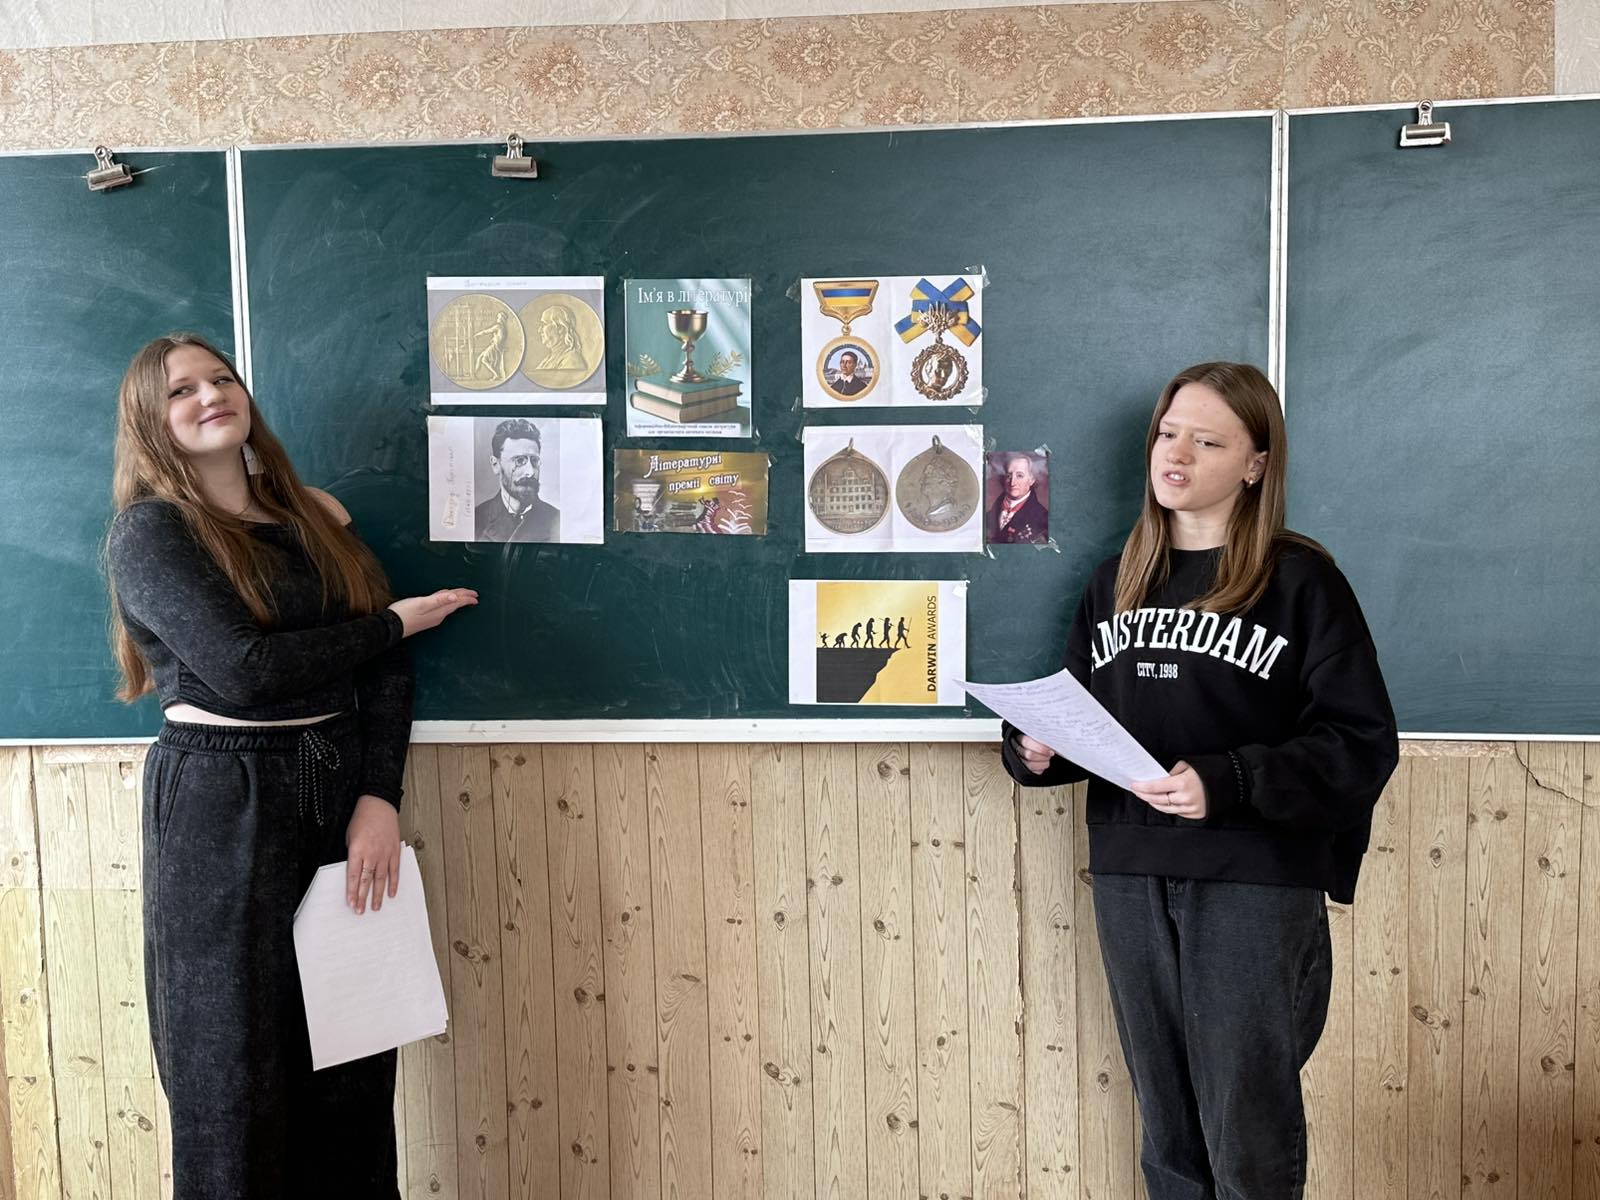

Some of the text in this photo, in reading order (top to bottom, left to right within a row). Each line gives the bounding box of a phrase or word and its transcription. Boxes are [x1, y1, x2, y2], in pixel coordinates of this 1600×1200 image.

[638, 287, 664, 304] Ім'я
[667, 290, 675, 303] в
[643, 453, 722, 478] Літературні
[669, 474, 739, 494] премії світу
[927, 595, 937, 692] DARWIN AWARDS
[1137, 661, 1158, 679] CITY,
